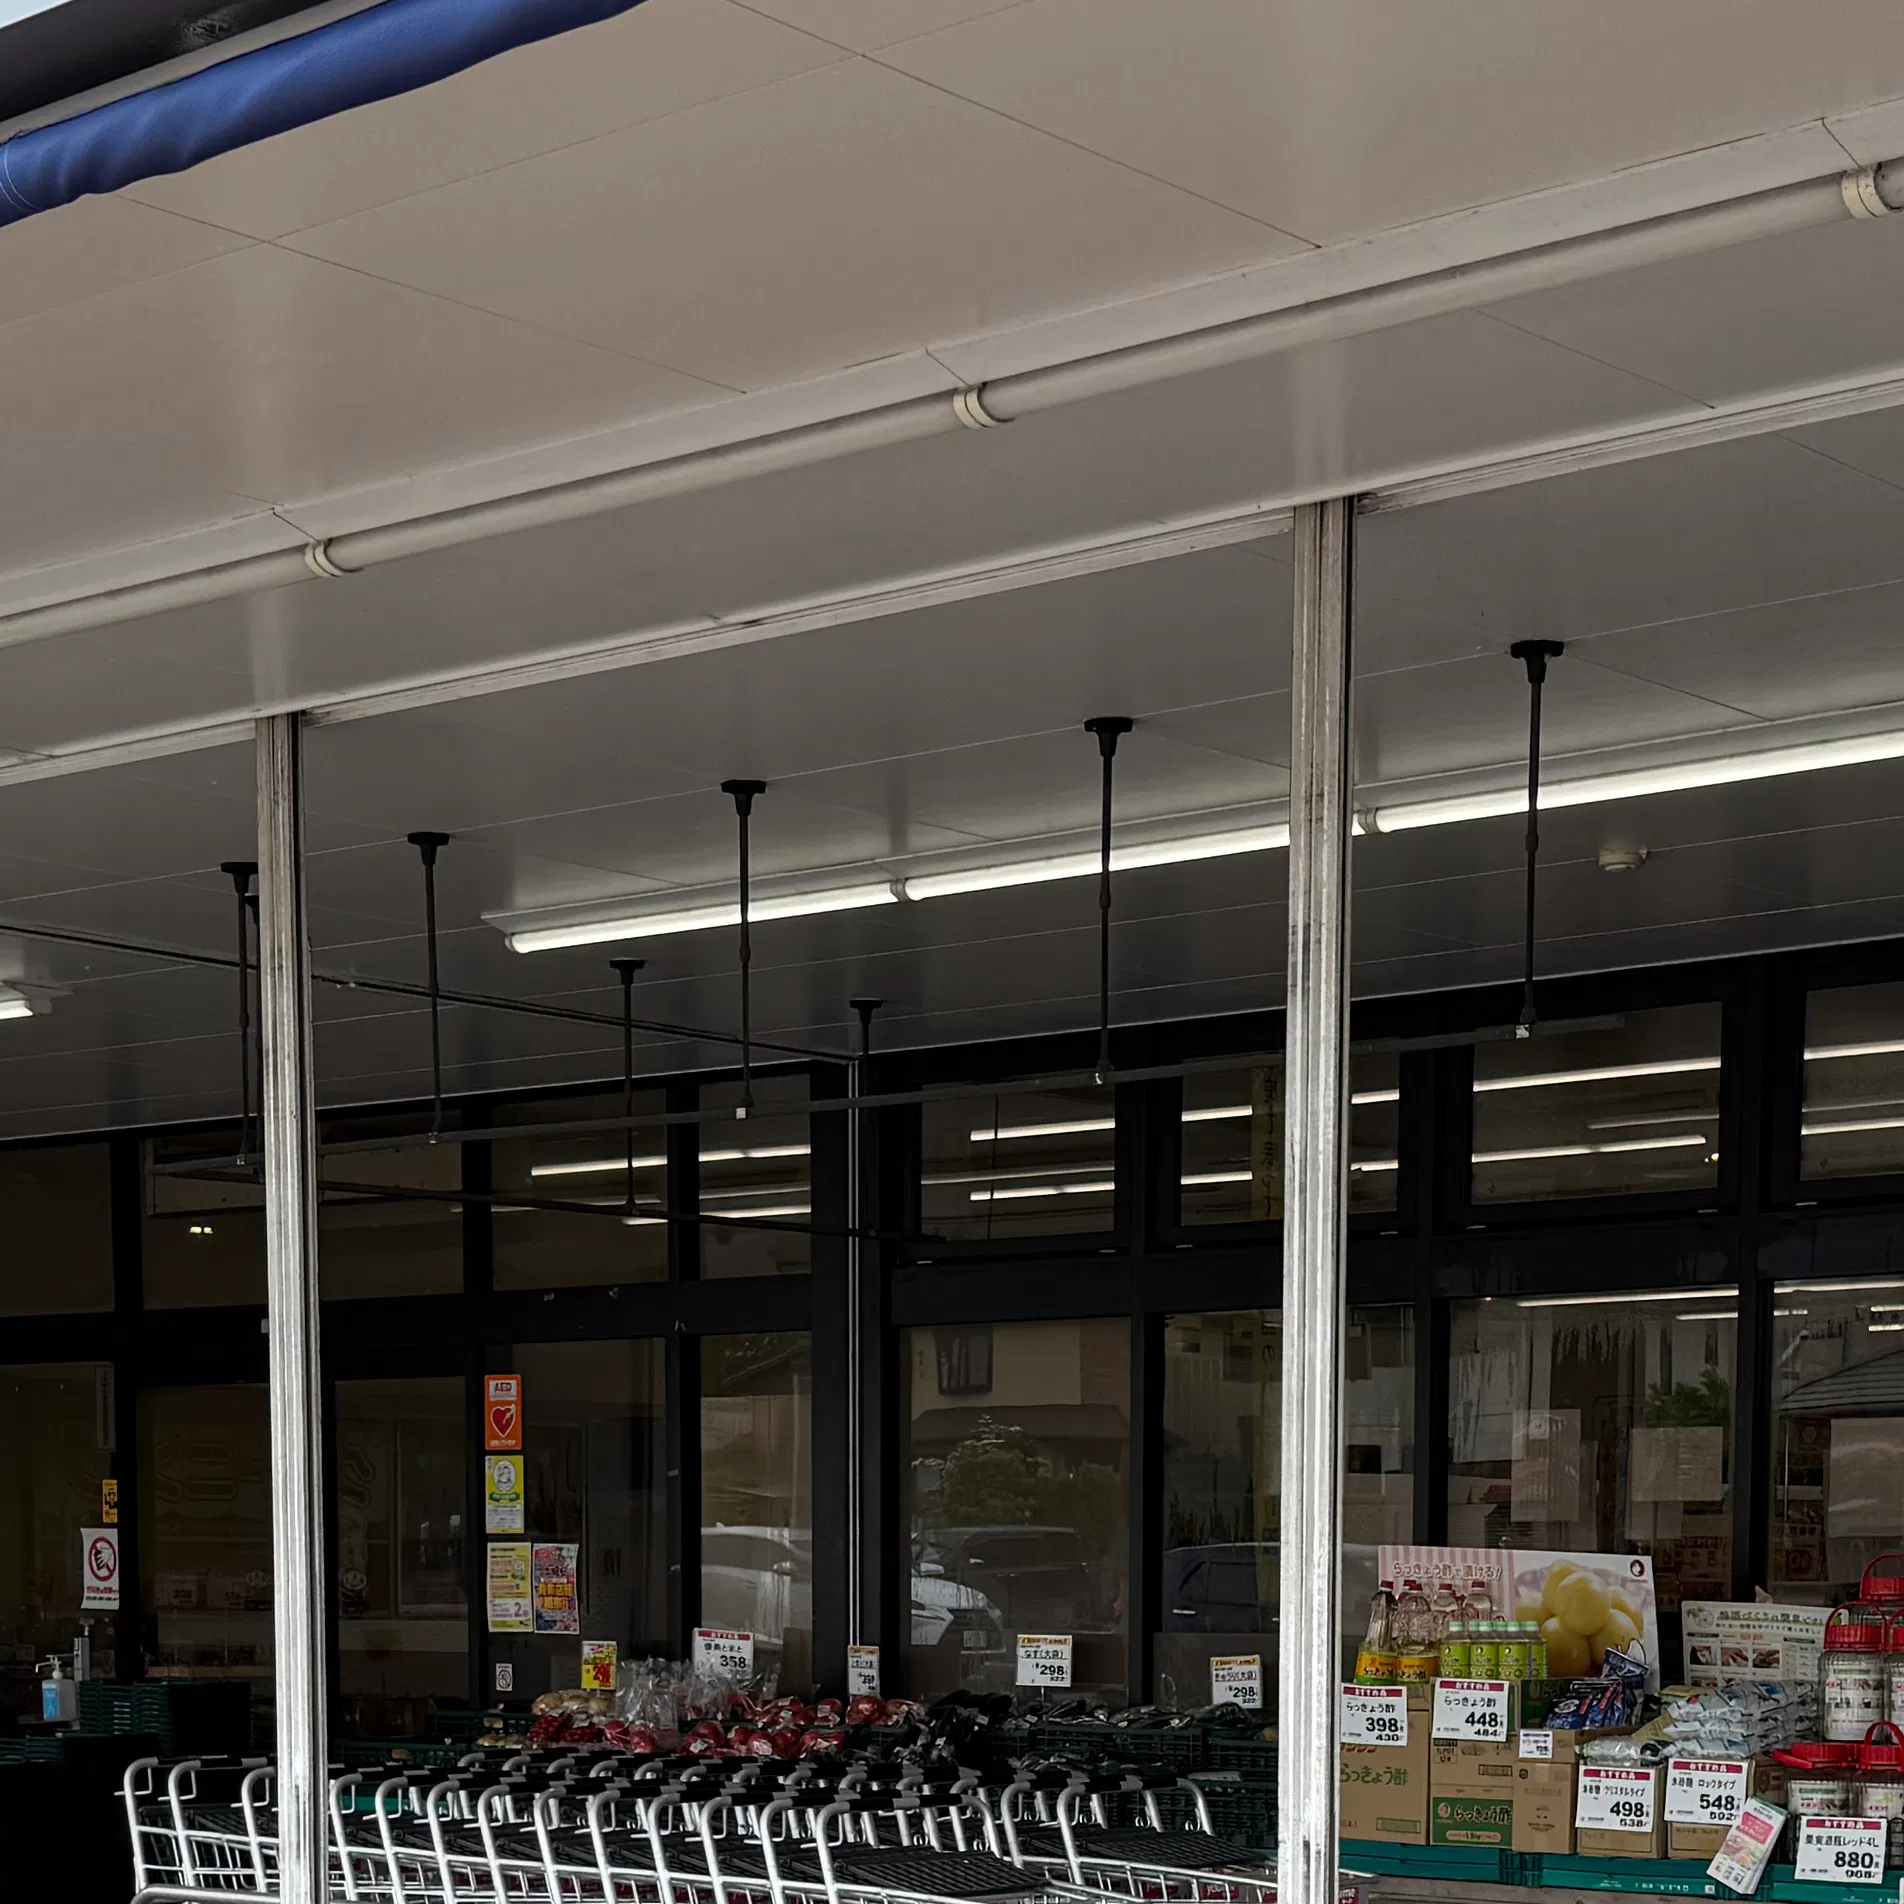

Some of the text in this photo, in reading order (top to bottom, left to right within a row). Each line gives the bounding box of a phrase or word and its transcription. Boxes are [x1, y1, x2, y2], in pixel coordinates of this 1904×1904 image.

[720, 1654, 747, 1669] 358
[1039, 1665, 1066, 1677] 298
[1232, 1685, 1257, 1698] 298
[1345, 1702, 1396, 1714] らっきょう酢
[1444, 1696, 1497, 1708] らっきょう酢
[1365, 1717, 1400, 1733] 398
[1464, 1711, 1499, 1728] 448
[1375, 1733, 1400, 1743] 430
[1473, 1729, 1498, 1738] 484
[1699, 1793, 1735, 1811] 548
[1609, 1801, 1645, 1818] 498
[1709, 1811, 1734, 1821] 592
[1834, 1851, 1875, 1868] 880
